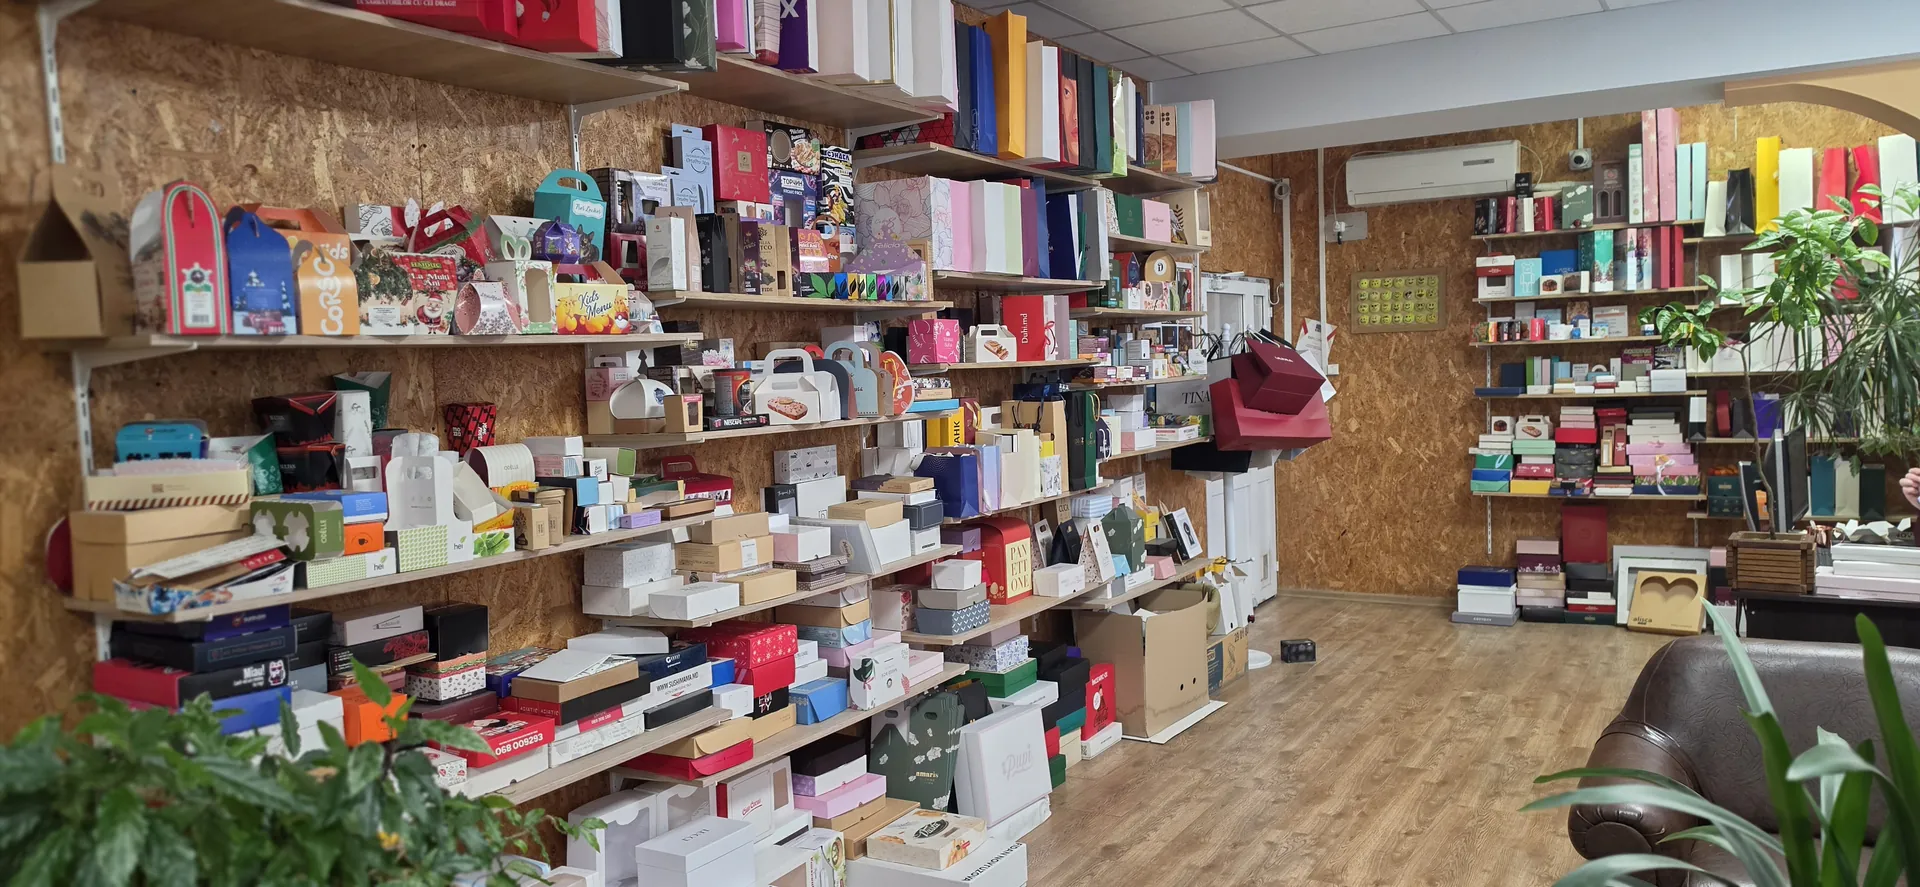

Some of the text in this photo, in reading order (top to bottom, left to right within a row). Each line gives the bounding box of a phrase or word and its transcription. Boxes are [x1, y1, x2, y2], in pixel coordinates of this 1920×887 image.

[578, 290, 599, 311] Kids
[585, 301, 612, 321] Menu
[1020, 313, 1029, 344] Duhi.md
[1010, 574, 1030, 592] ONE
[495, 733, 544, 756] 068 009293
